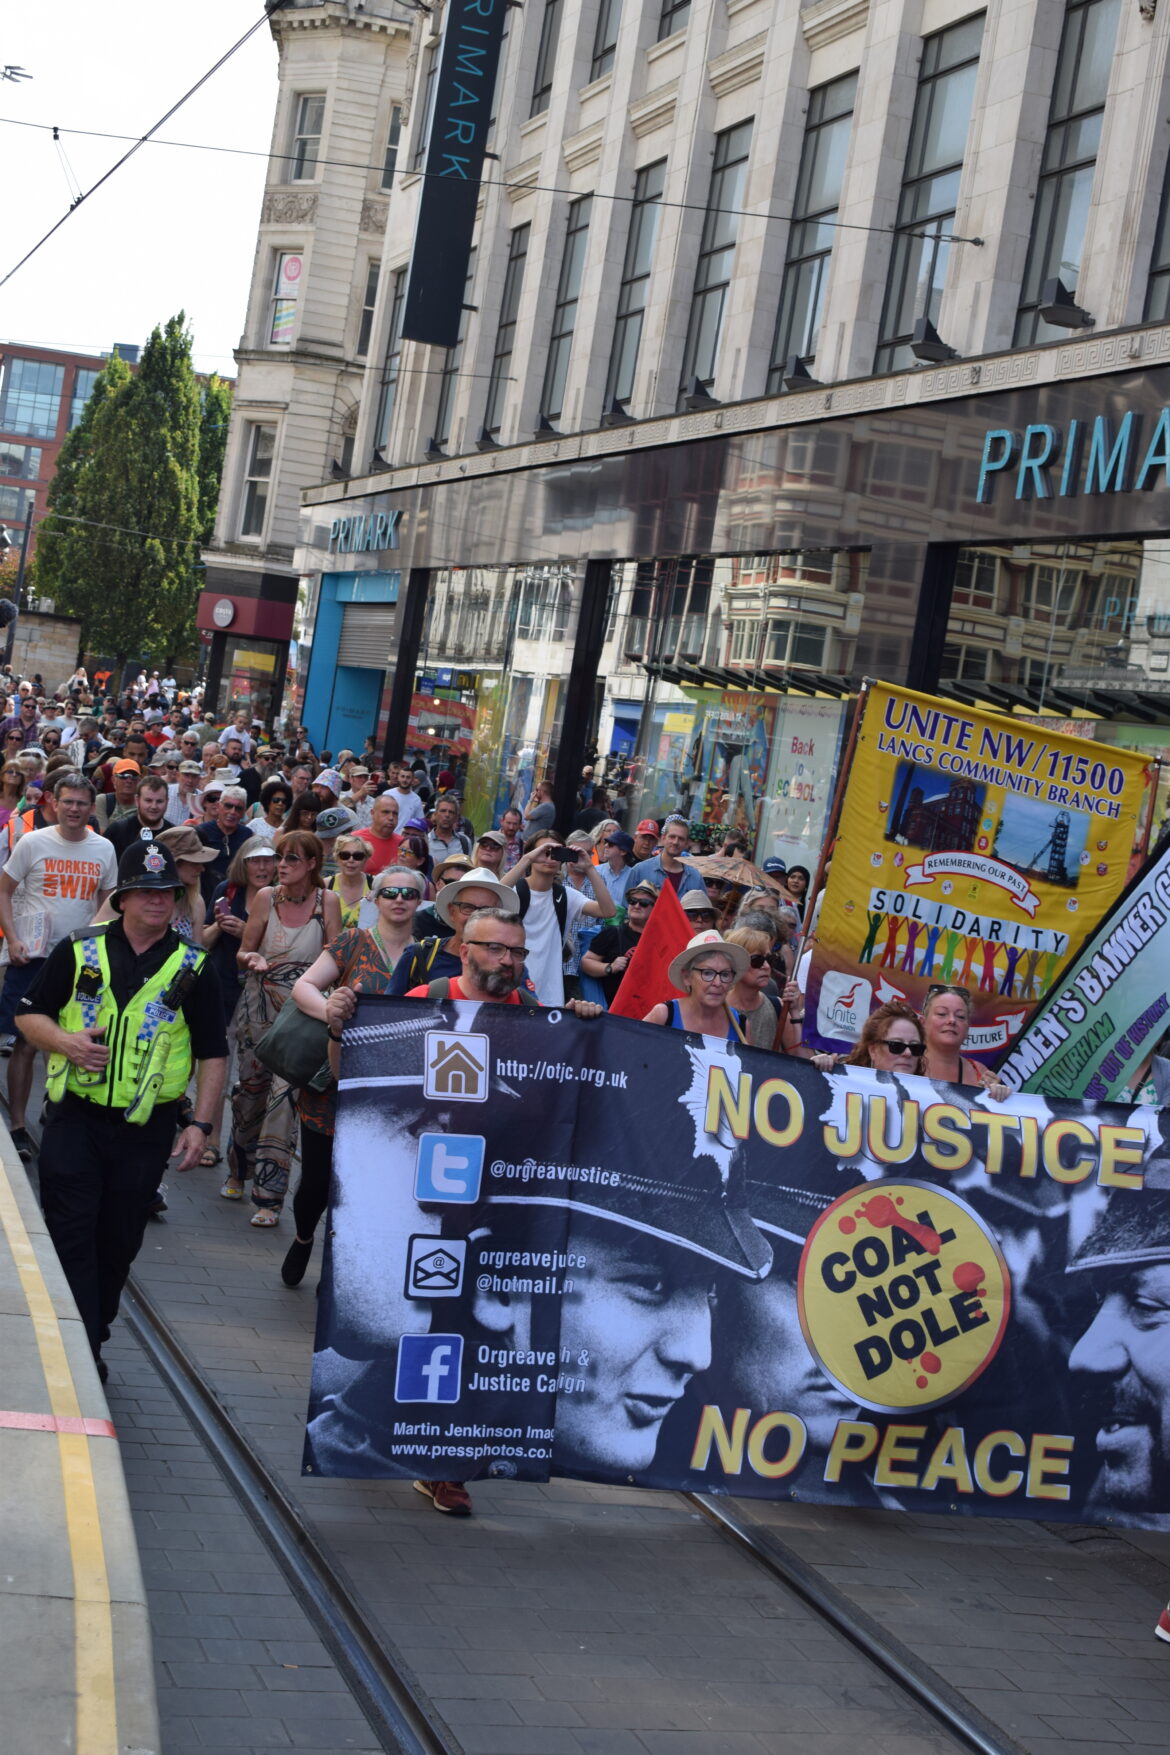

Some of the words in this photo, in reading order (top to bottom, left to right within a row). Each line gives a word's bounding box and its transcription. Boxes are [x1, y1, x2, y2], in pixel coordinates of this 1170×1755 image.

[327, 510, 402, 553] PRIMARK
[791, 736, 815, 757] Back
[884, 697, 975, 753] UNITE
[877, 731, 935, 765] LANCS
[937, 752, 1046, 798] COMMUNITY
[1046, 783, 1122, 820] BRANCH
[42, 873, 59, 897] CAN
[60, 874, 99, 900] WIN
[43, 857, 102, 877] WORKERS
[927, 858, 986, 873] REMEMBERING
[987, 866, 1006, 880] OUR
[1006, 875, 1028, 893] PAST
[872, 890, 1066, 953] SOLIDARITY
[149, 1006, 170, 1020] POLICE
[826, 1006, 857, 1024] Unite
[999, 989, 1087, 1093] OMEN'S
[1074, 891, 1168, 1006] BANNER
[1049, 1011, 1116, 1091] DURHAM
[1098, 1049, 1126, 1083] OUT
[1114, 1034, 1135, 1060] OF
[1125, 991, 1170, 1046] HISTORY
[496, 1058, 628, 1089] http://otjc.org.uk
[704, 1065, 805, 1147] NO
[823, 1091, 1146, 1191] JUSTICE
[820, 1210, 957, 1294] COAL
[856, 1258, 943, 1327] NOT
[478, 1345, 556, 1368] Orgreave
[854, 1288, 990, 1381] DOLE
[468, 1372, 531, 1392] Justice
[393, 1422, 441, 1436] Martin
[444, 1423, 522, 1438] Jenkinson
[690, 1404, 808, 1479] NO
[823, 1418, 1074, 1501] PEACE
